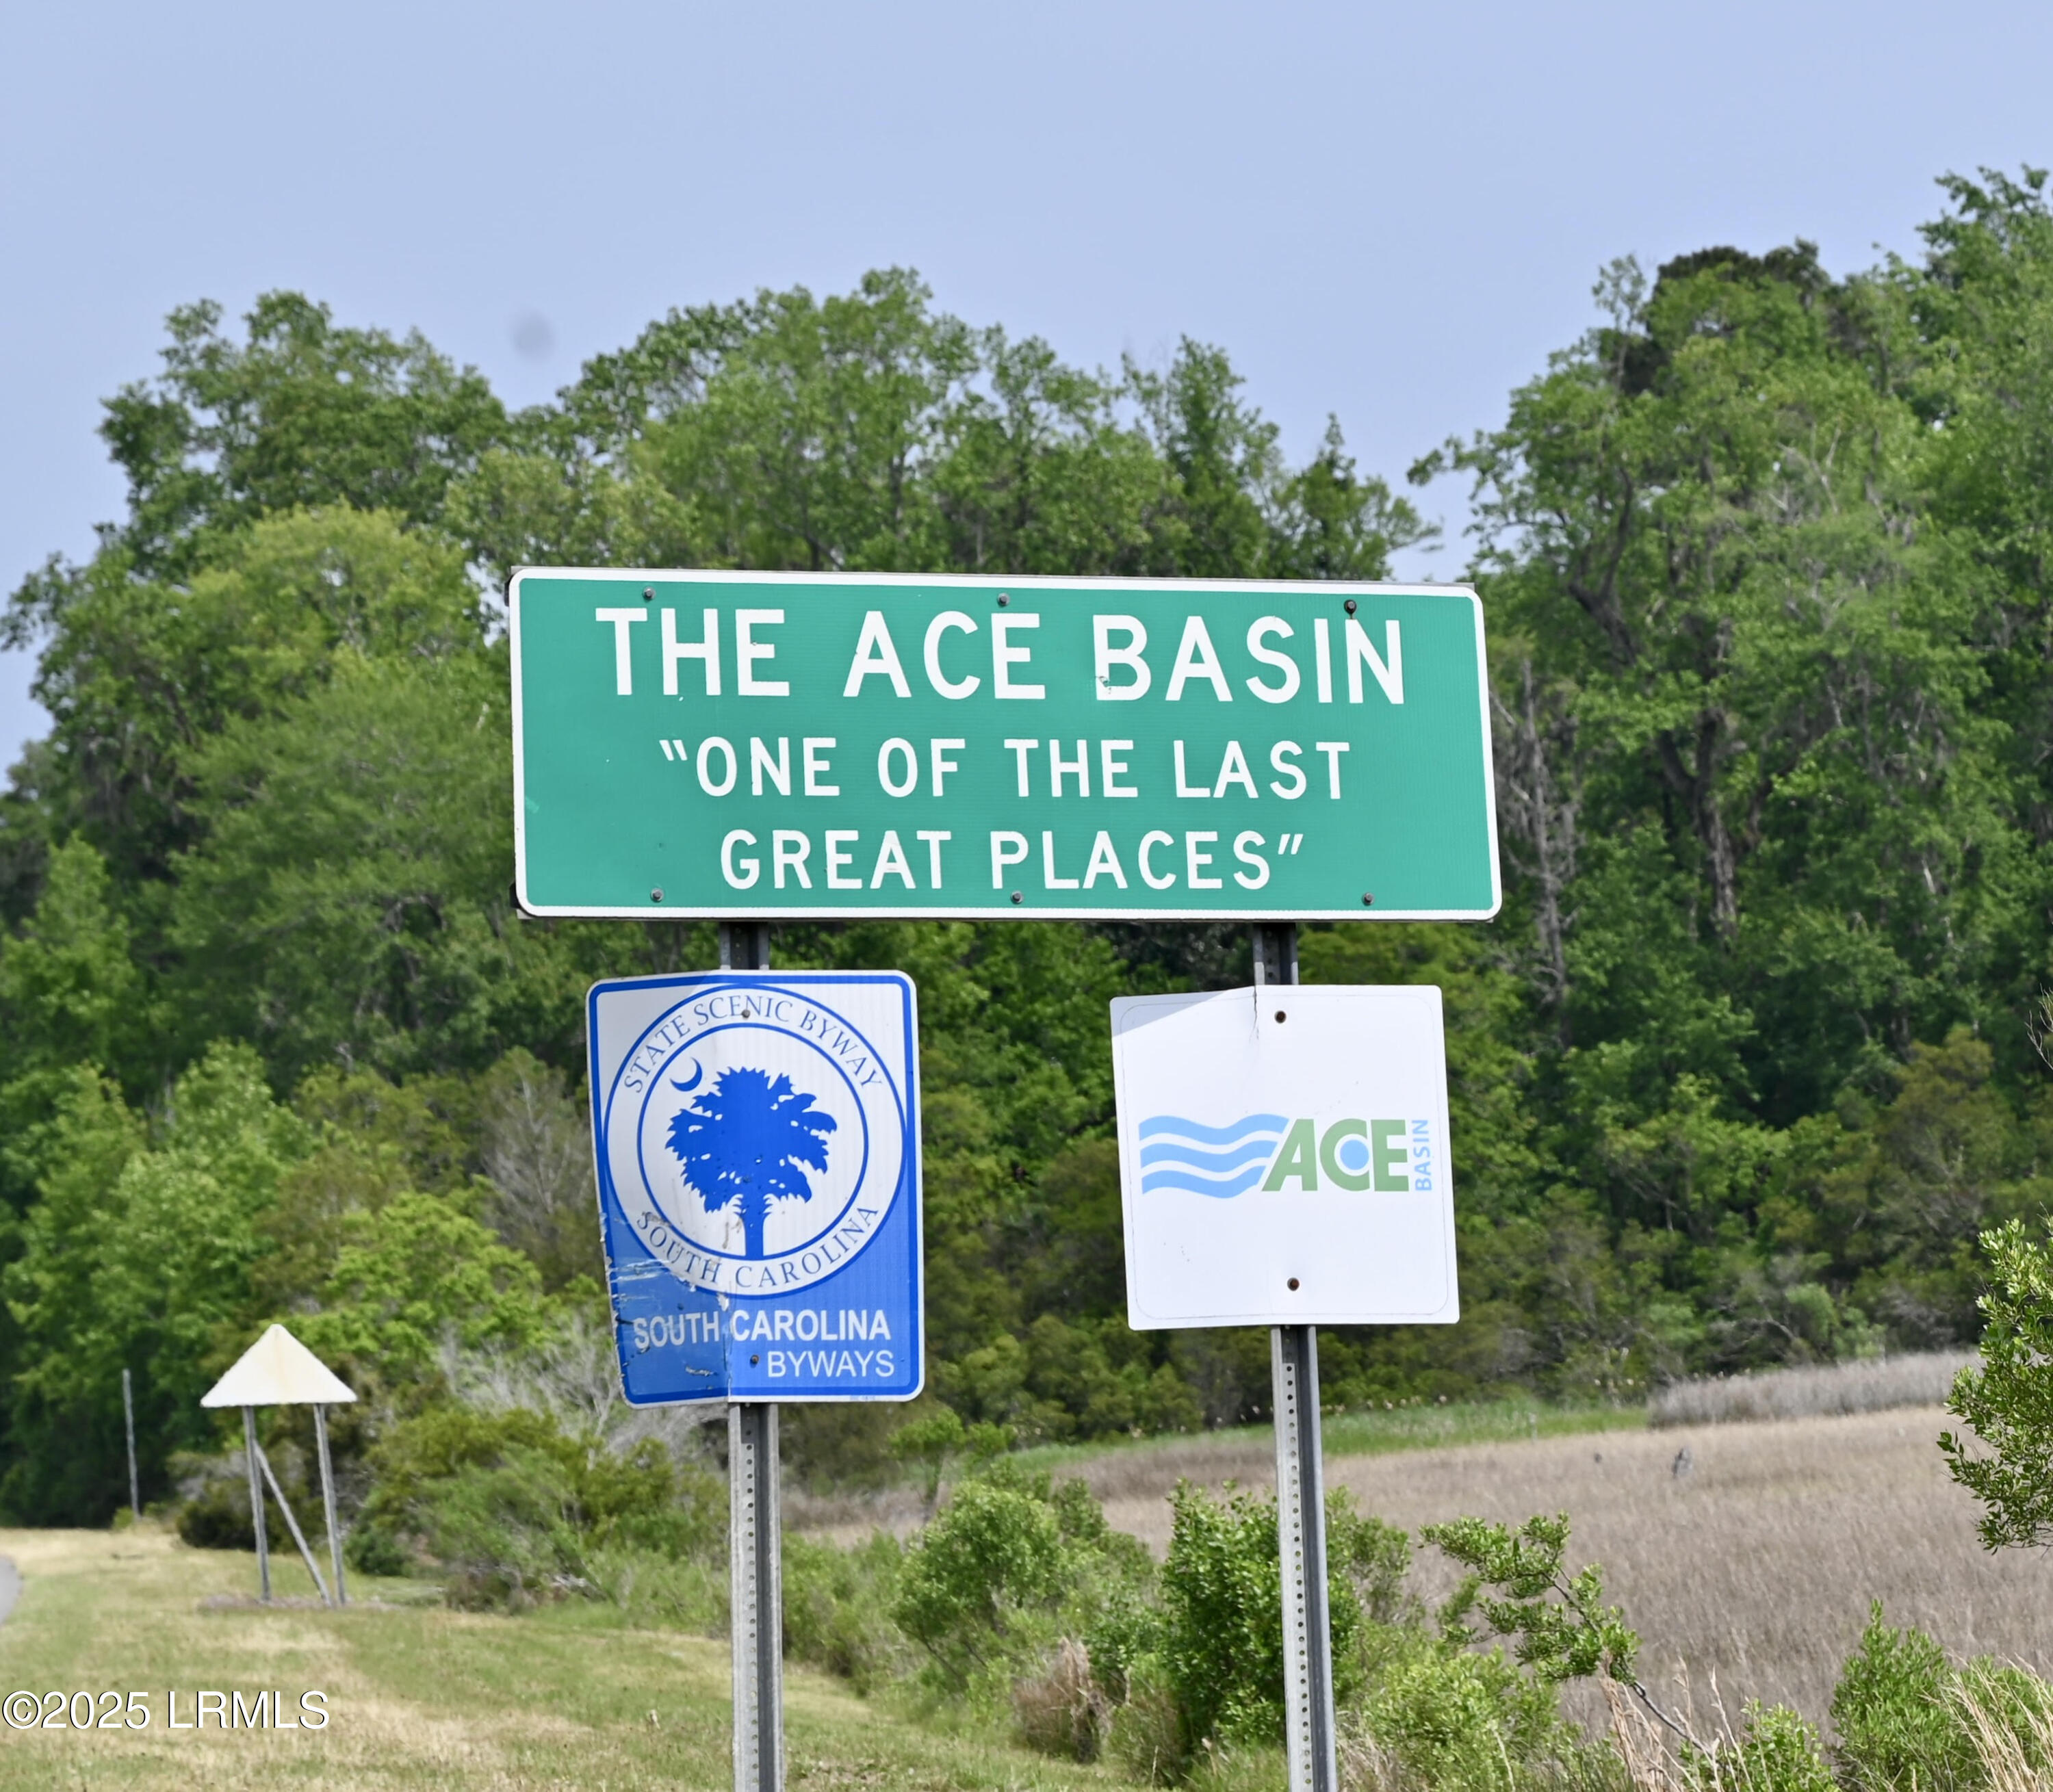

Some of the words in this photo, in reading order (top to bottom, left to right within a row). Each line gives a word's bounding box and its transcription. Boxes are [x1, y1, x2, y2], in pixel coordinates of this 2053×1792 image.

[595, 607, 790, 698] THE
[842, 610, 1047, 701] ACE
[1093, 614, 1405, 705] BASIN
[877, 737, 966, 798] OF
[1003, 738, 1139, 799] THE
[1174, 740, 1352, 801] LAST
[719, 828, 953, 890] GREAT
[623, 1014, 691, 1094] STATE
[693, 994, 794, 1026] SCENIC
[799, 1009, 883, 1092] BYWAY
[1261, 1117, 1410, 1192] ACE
[1412, 1119, 1433, 1192] BASIN
[636, 1210, 723, 1284] SOUTH
[734, 1205, 879, 1289] CAROLINA
[632, 1311, 721, 1350] SOUTH
[729, 1309, 892, 1342] CAROLINA
[767, 1349, 896, 1379] BYWAYS
